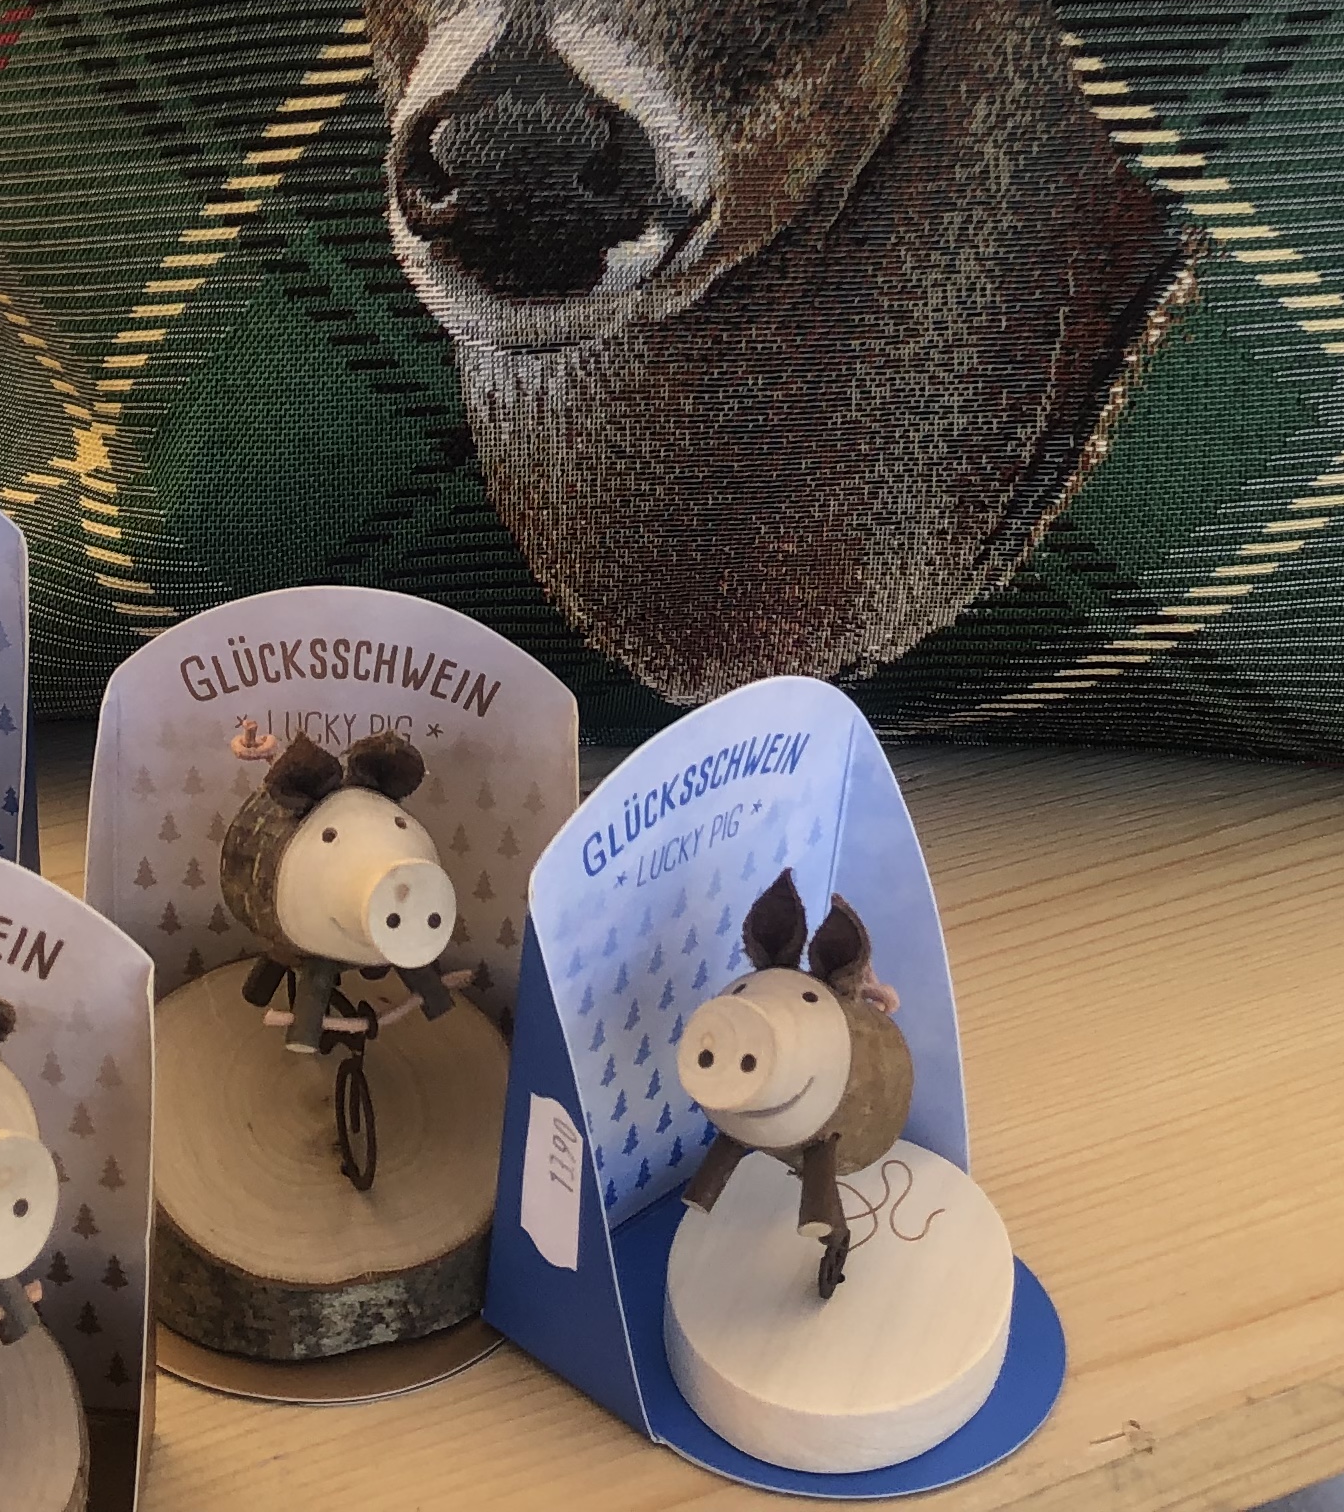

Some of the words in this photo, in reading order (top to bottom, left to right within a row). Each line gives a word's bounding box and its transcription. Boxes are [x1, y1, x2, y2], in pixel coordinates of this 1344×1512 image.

[179, 635, 502, 718] GLÜCKSSCHWEIN
[581, 731, 812, 878] GLÜCKSSCHWEIN
[635, 828, 704, 888] LUCKY
[708, 802, 744, 849] PIG
